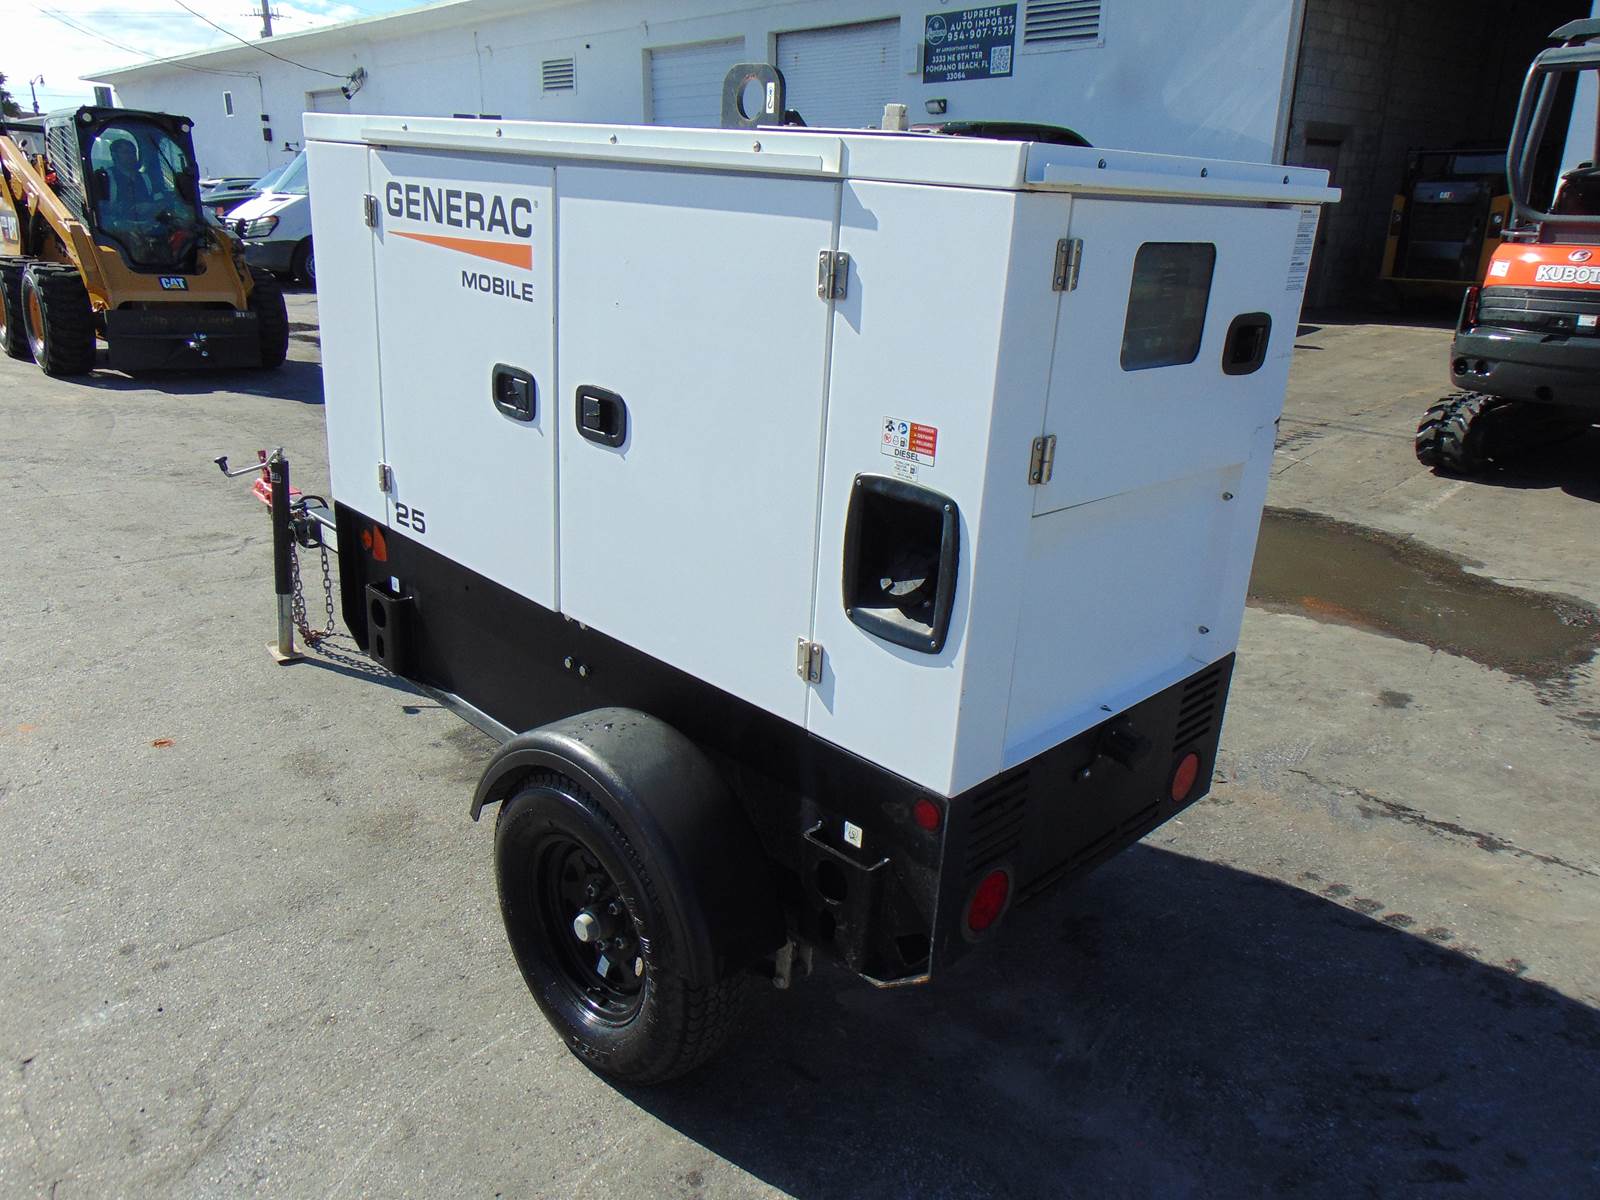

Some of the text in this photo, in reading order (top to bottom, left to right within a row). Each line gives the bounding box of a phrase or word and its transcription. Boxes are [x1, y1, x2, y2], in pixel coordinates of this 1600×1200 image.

[963, 8, 1001, 20] SUPREME
[950, 16, 1013, 31] AUTO IMPORTS
[971, 51, 983, 59] TER
[926, 63, 956, 72] POMPANO
[981, 60, 989, 68] FL
[946, 72, 966, 80] 33064
[386, 181, 533, 238] GENERAC
[161, 278, 186, 289] CAT
[461, 270, 533, 302] MOBILE
[894, 449, 919, 461] DIESEL
[395, 502, 426, 534] 25
